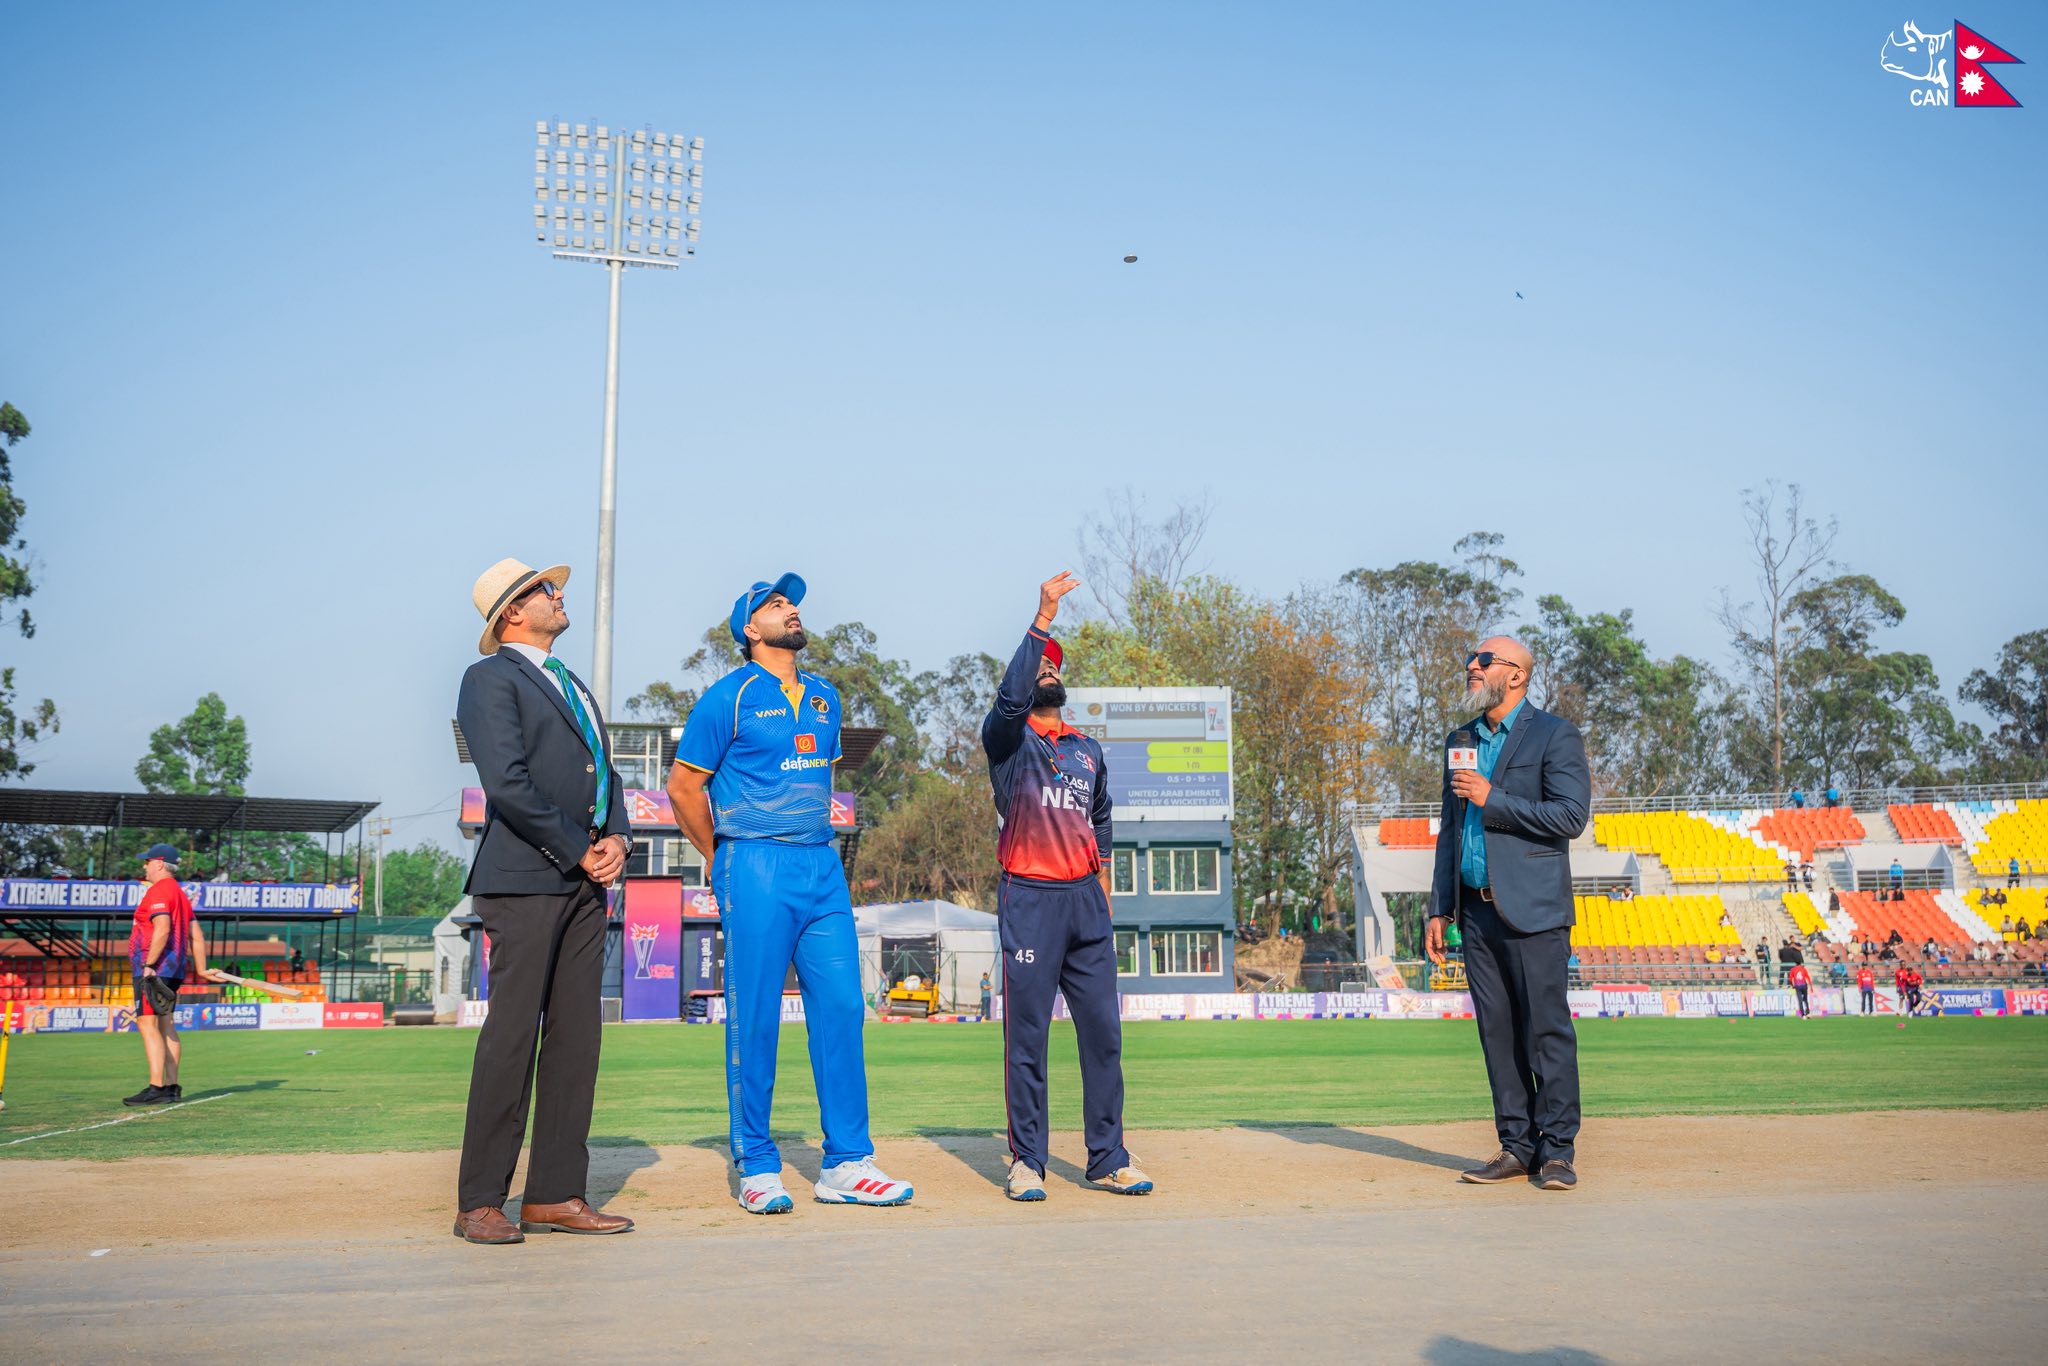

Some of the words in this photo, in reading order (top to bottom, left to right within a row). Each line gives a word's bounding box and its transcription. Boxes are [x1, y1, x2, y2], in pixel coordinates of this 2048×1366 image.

[1110, 703, 1132, 713] WON
[1135, 703, 1147, 713] BY
[1148, 703, 1154, 713] 6
[1157, 703, 1197, 713] WICKETS
[780, 757, 828, 772] dafaNEWS
[1128, 790, 1159, 798] UNITED
[1160, 790, 1184, 798] ARAB
[1185, 790, 1221, 798] EMIRATE
[1128, 798, 1149, 806] WON
[1151, 798, 1162, 806] BY
[1164, 798, 1170, 806] 6
[1171, 798, 1207, 806] WICKETS
[8, 883, 67, 906] XTREME
[70, 884, 125, 907] ENERGY
[204, 885, 260, 908] XTREME
[261, 886, 312, 909] ENERGY
[313, 887, 353, 909] DRINK
[1014, 949, 1035, 963] 45
[1128, 994, 1184, 1009] XTREME
[1195, 994, 1251, 1009] XTREME
[1259, 993, 1314, 1008] XTREME
[1327, 993, 1384, 1008] XTREME
[1604, 991, 1632, 1004] MAX
[1632, 991, 1662, 1004] TIGER
[1683, 991, 1710, 1004] MAX
[1711, 991, 1742, 1004] TIGER
[1751, 995, 1779, 1010] BAM
[1942, 994, 1982, 1004] XTREME
[53, 1007, 80, 1019] MAX
[81, 1007, 109, 1019] TIGER
[215, 1006, 258, 1017] NAASA
[215, 1017, 258, 1026] SECURITIES
